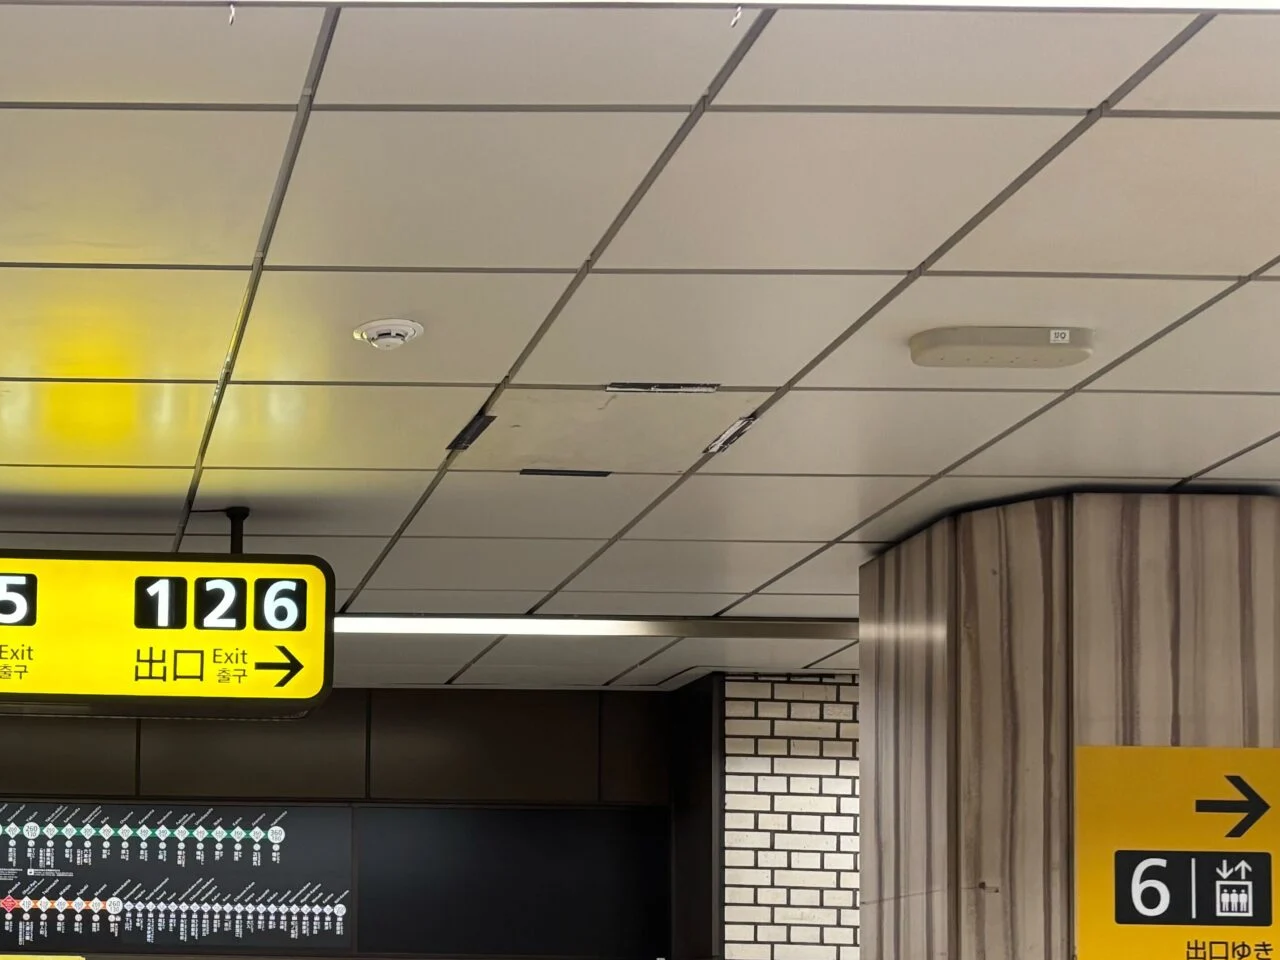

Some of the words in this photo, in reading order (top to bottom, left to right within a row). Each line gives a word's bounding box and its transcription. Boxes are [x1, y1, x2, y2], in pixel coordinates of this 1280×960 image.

[146, 579, 169, 627] 1
[204, 580, 237, 628] 2
[263, 581, 298, 629] 6
[0, 645, 34, 662] Exit
[213, 648, 248, 665] Exit
[0, 664, 29, 680] 출구
[135, 647, 204, 683] 出口
[217, 667, 248, 684] 출구
[1131, 857, 1170, 917] 6
[1186, 940, 1273, 960] 出口ゆき
